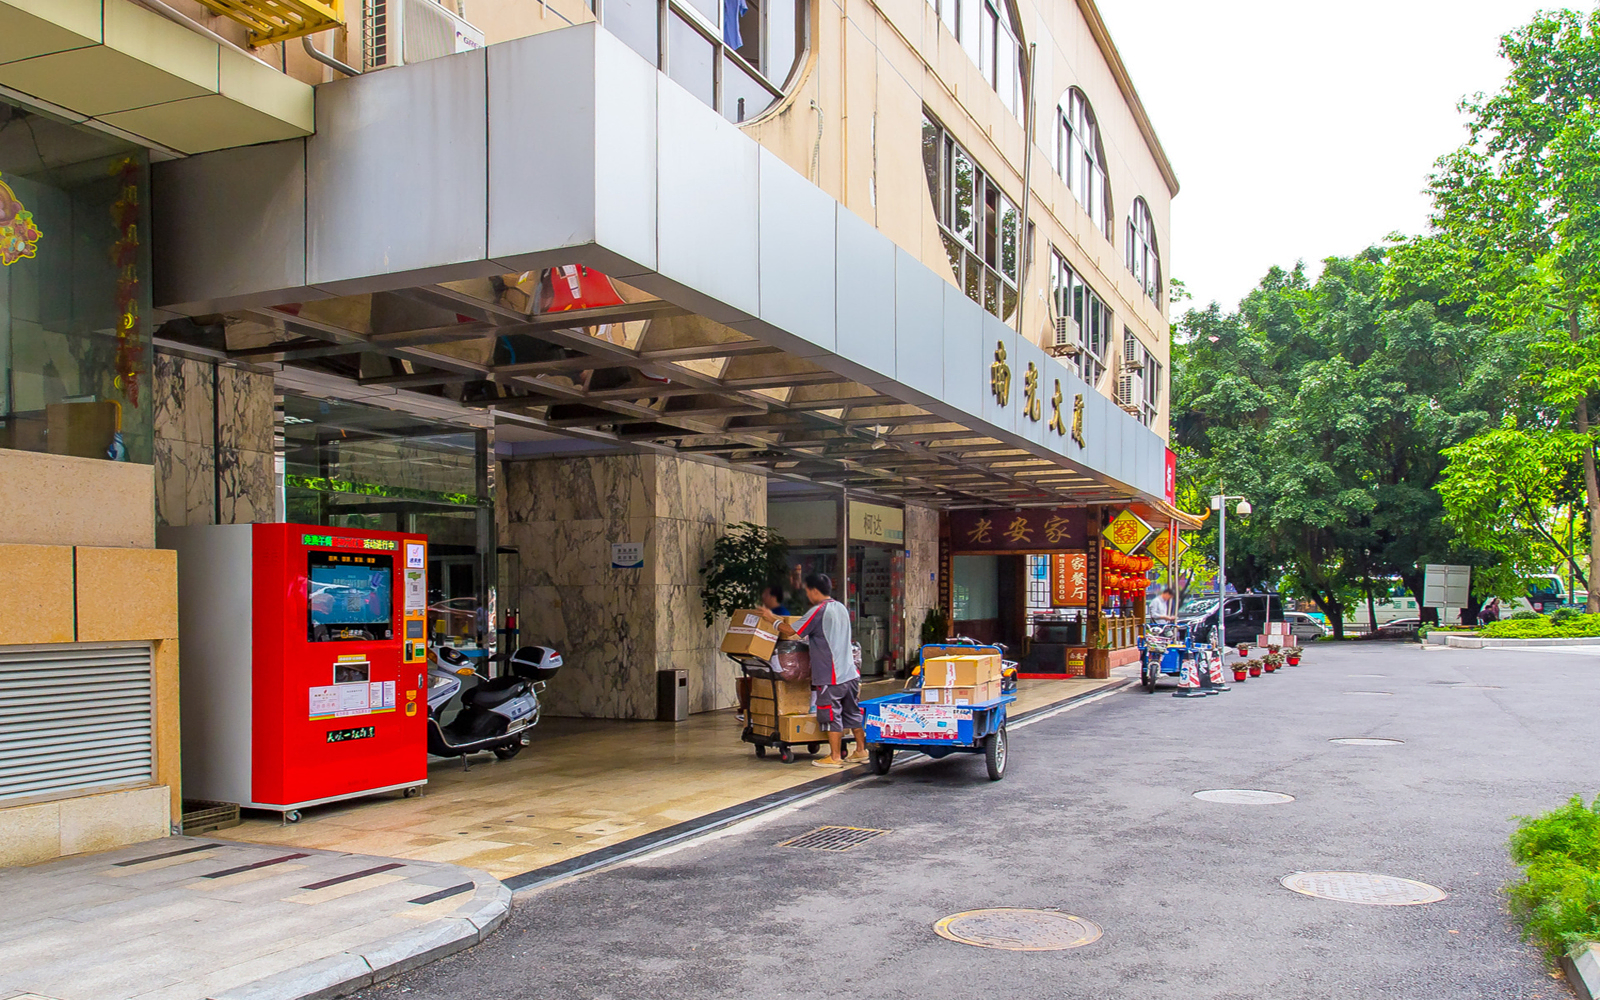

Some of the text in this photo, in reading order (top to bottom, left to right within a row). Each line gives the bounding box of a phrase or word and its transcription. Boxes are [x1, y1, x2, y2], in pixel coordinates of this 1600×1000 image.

[863, 512, 883, 536] 柯达
[966, 515, 1072, 544] 老安家
[1070, 554, 1088, 600] 家餐厅
